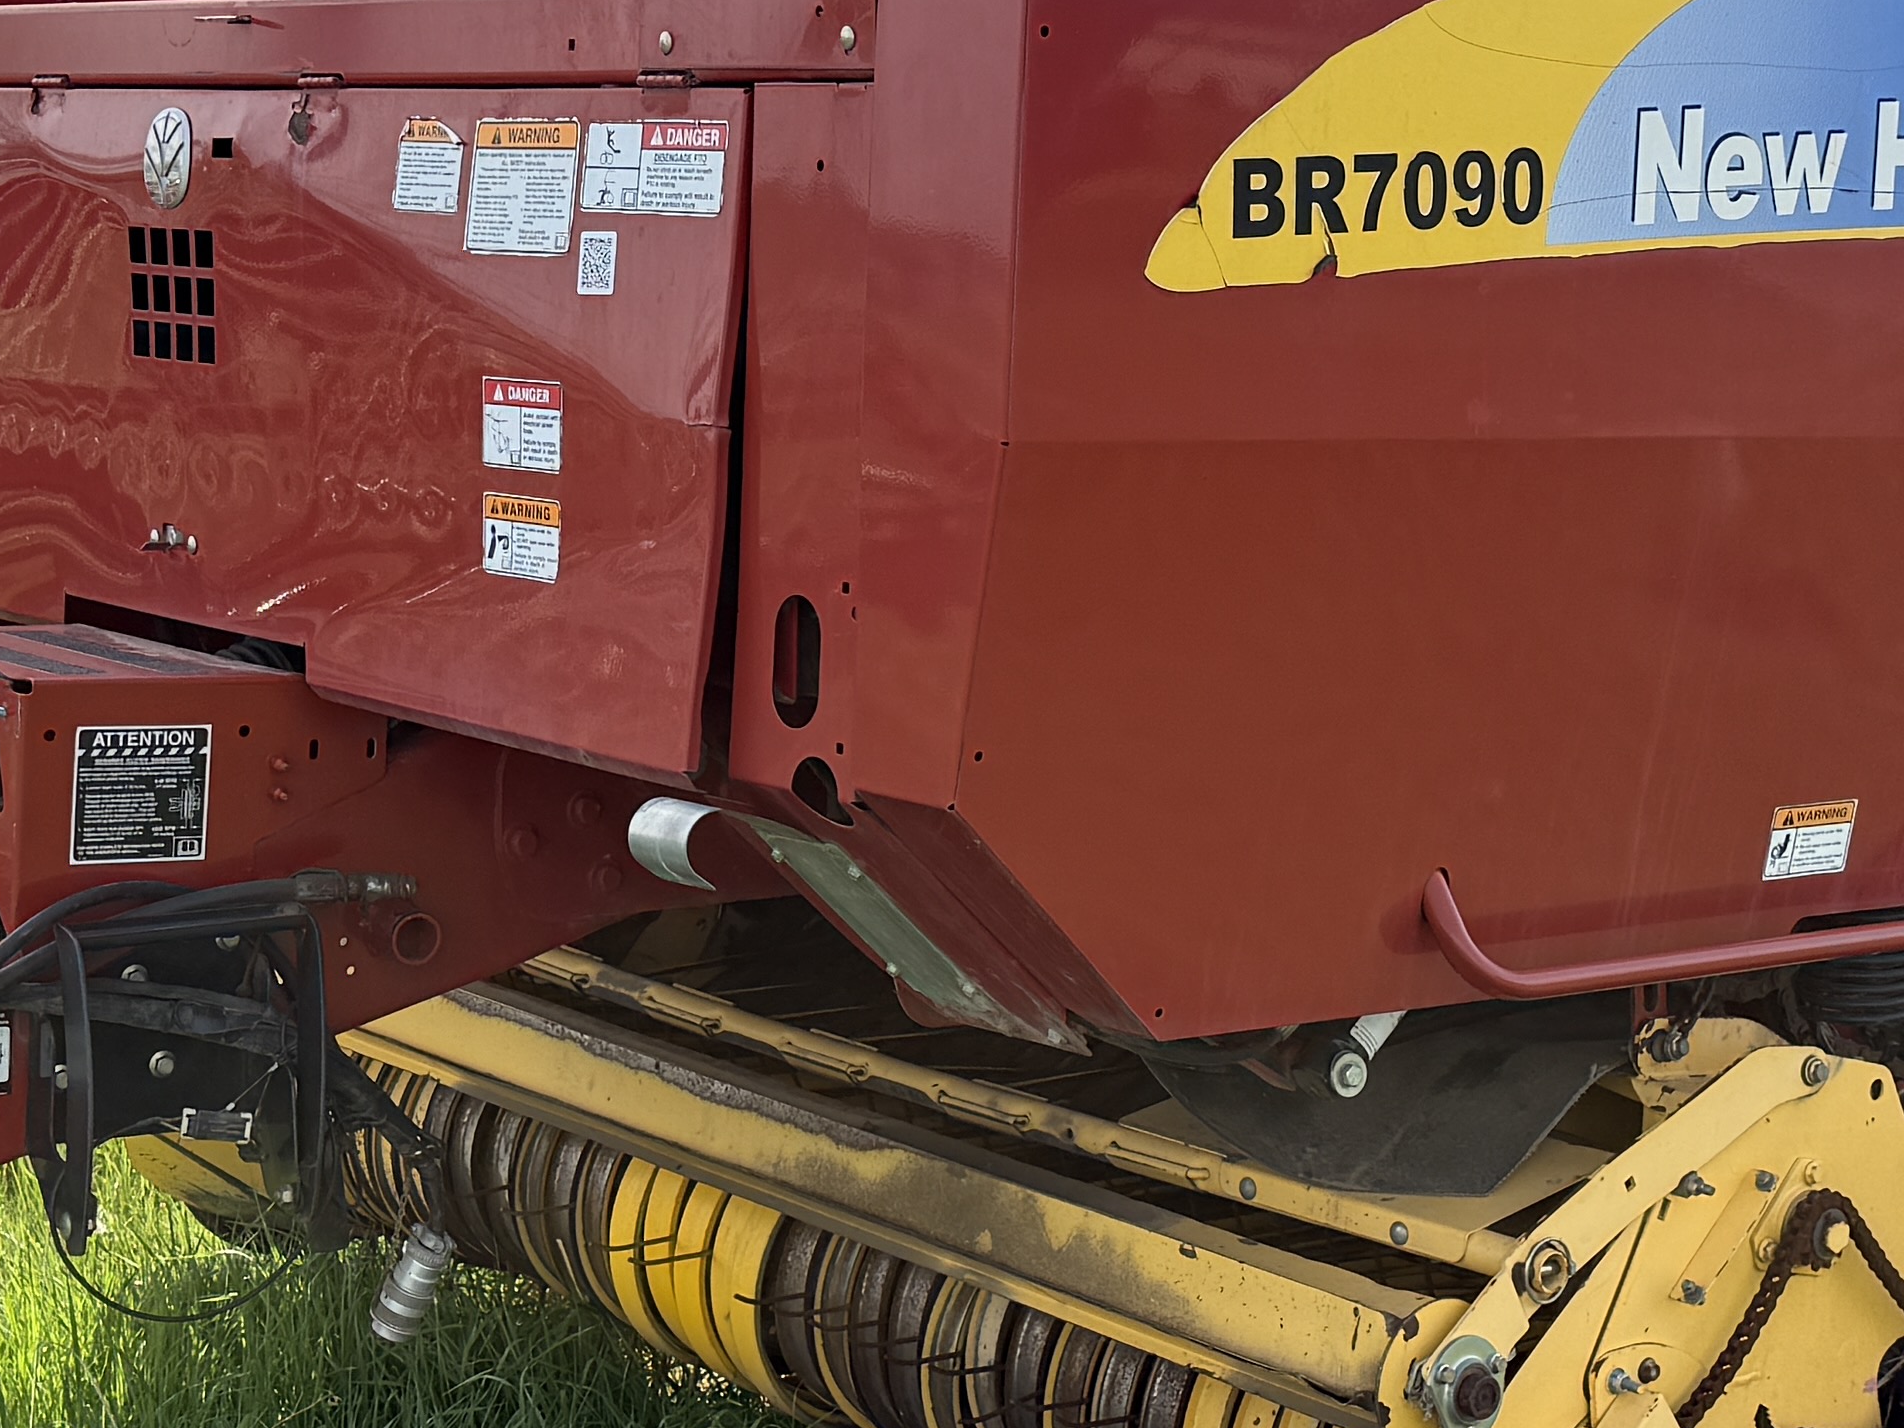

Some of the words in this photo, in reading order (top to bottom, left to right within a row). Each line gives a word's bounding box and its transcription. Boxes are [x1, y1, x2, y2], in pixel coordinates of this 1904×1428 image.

[508, 127, 561, 144] WARNING
[666, 127, 720, 147] DANGER
[1631, 105, 1849, 226] New
[1232, 147, 1545, 239] BR7090
[507, 385, 551, 404] DANGER
[500, 501, 551, 521] WARNING
[92, 730, 196, 748] ATTENTION
[1796, 807, 1848, 823] WARNING
